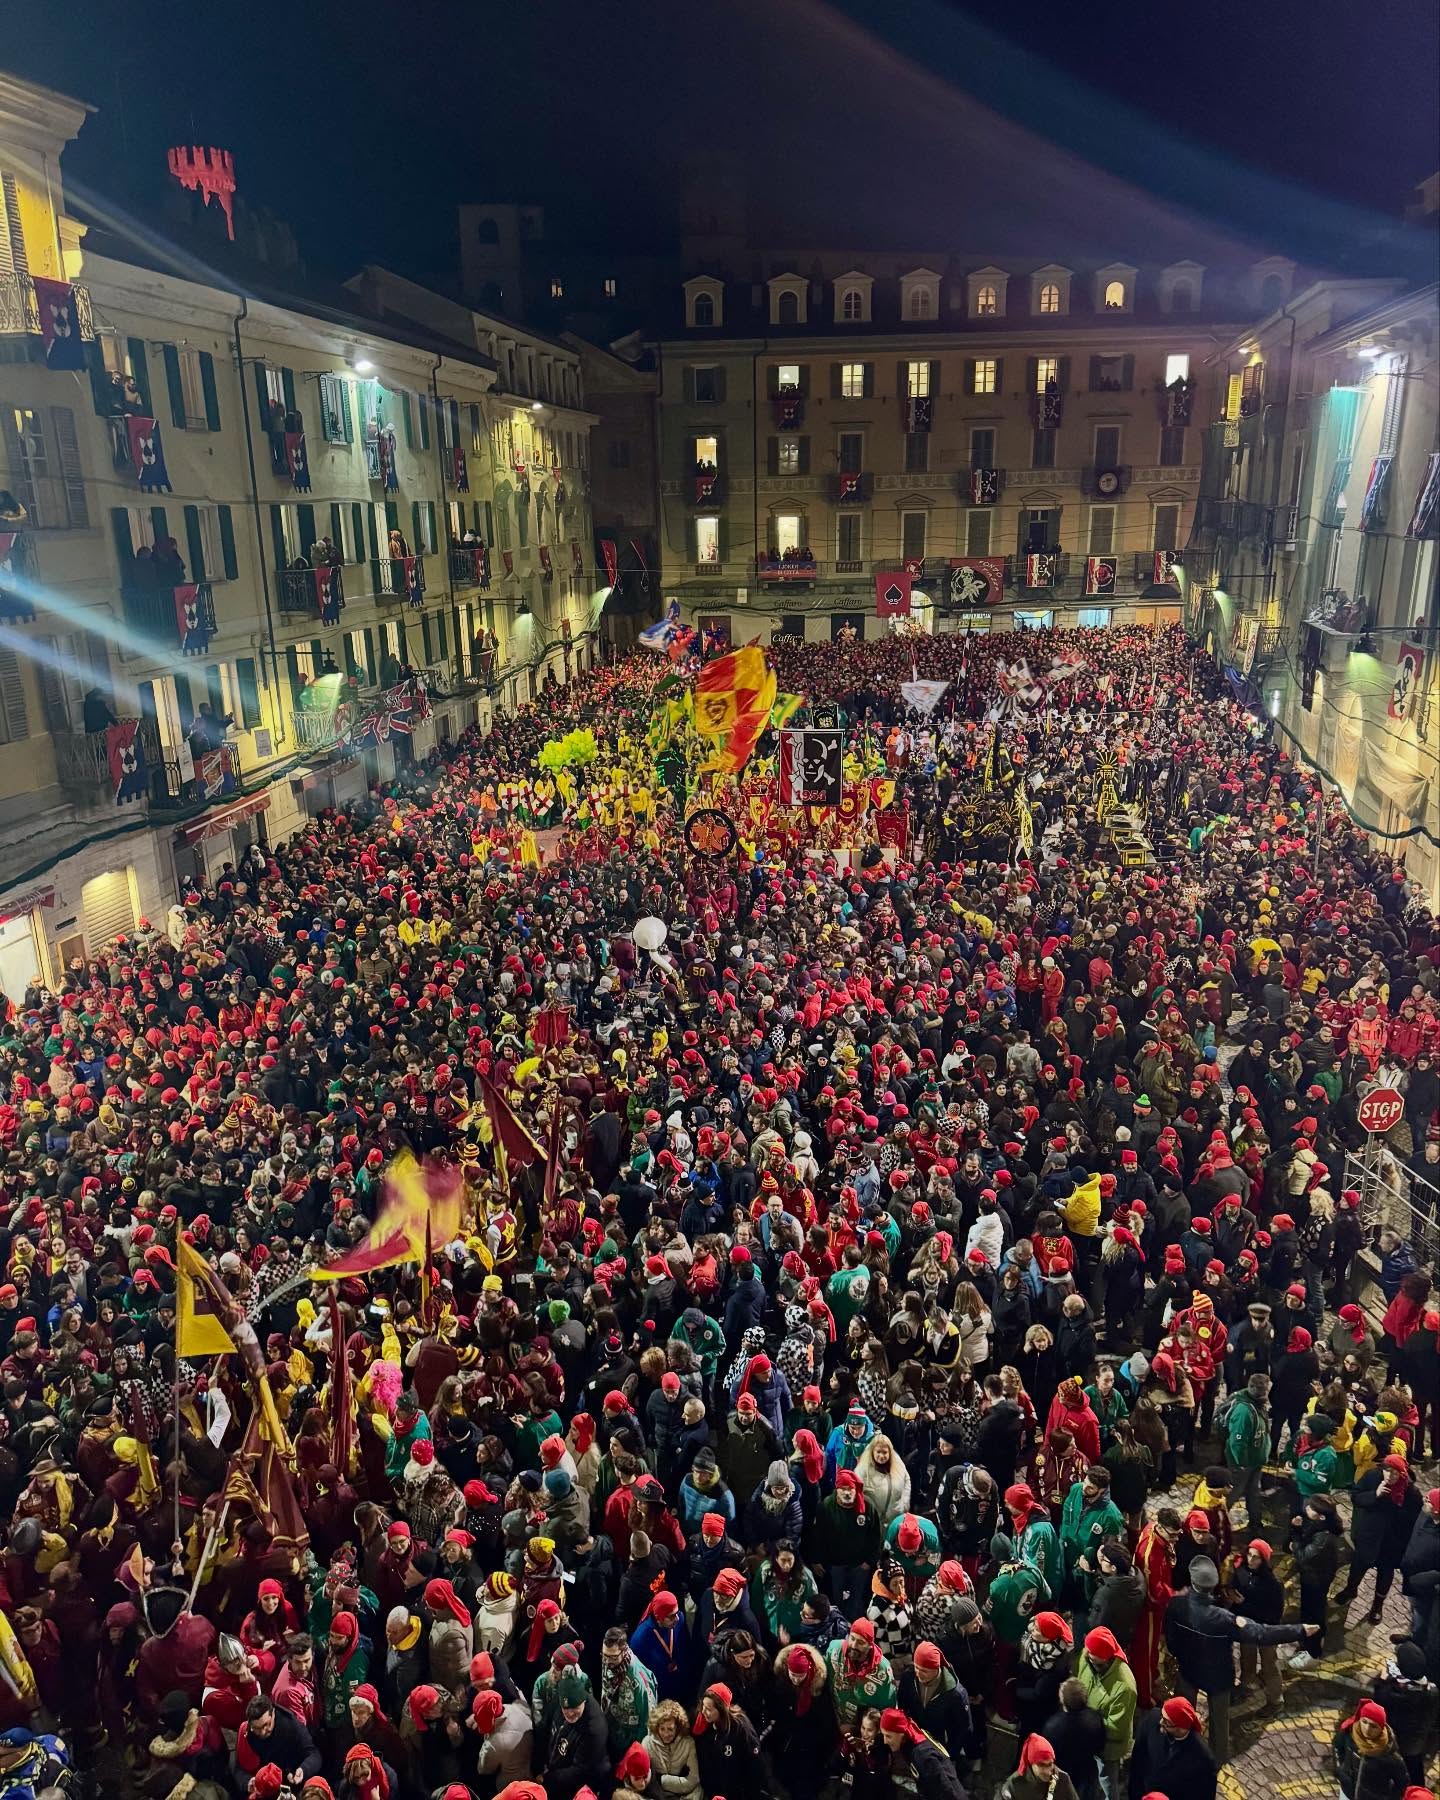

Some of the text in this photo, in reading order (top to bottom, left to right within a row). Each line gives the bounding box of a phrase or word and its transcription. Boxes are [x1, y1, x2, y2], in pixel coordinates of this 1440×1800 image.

[833, 596, 862, 608] Caffaro
[796, 789, 826, 801] 1954
[692, 966, 706, 977] 50
[1361, 1101, 1401, 1119] STOP
